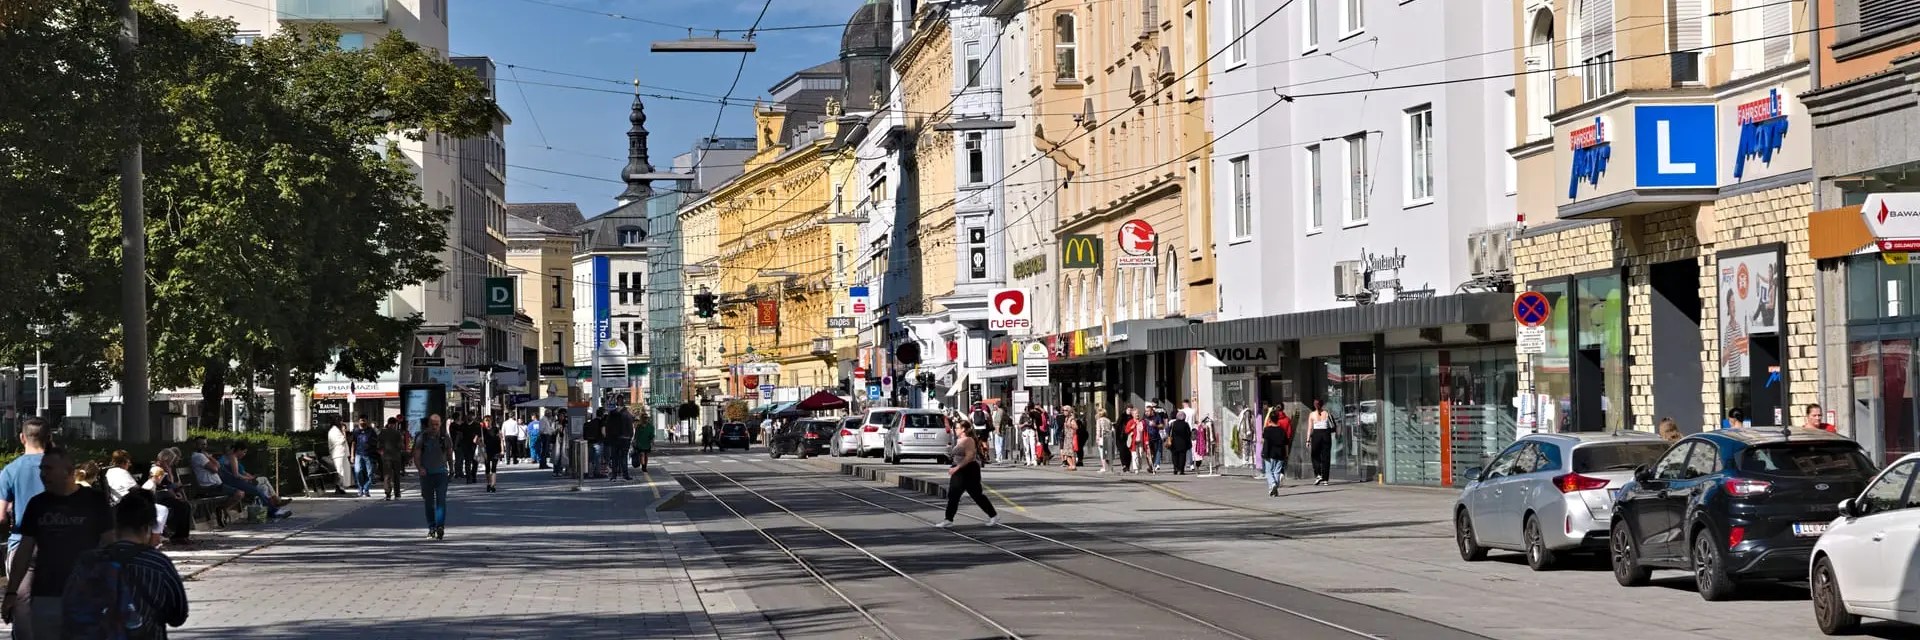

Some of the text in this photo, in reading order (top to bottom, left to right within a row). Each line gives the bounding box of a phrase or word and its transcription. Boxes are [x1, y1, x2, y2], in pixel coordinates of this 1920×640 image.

[1657, 120, 1696, 174] L
[492, 286, 508, 303] D
[990, 318, 1029, 329] ruefa
[1214, 347, 1267, 361] VIOLA
